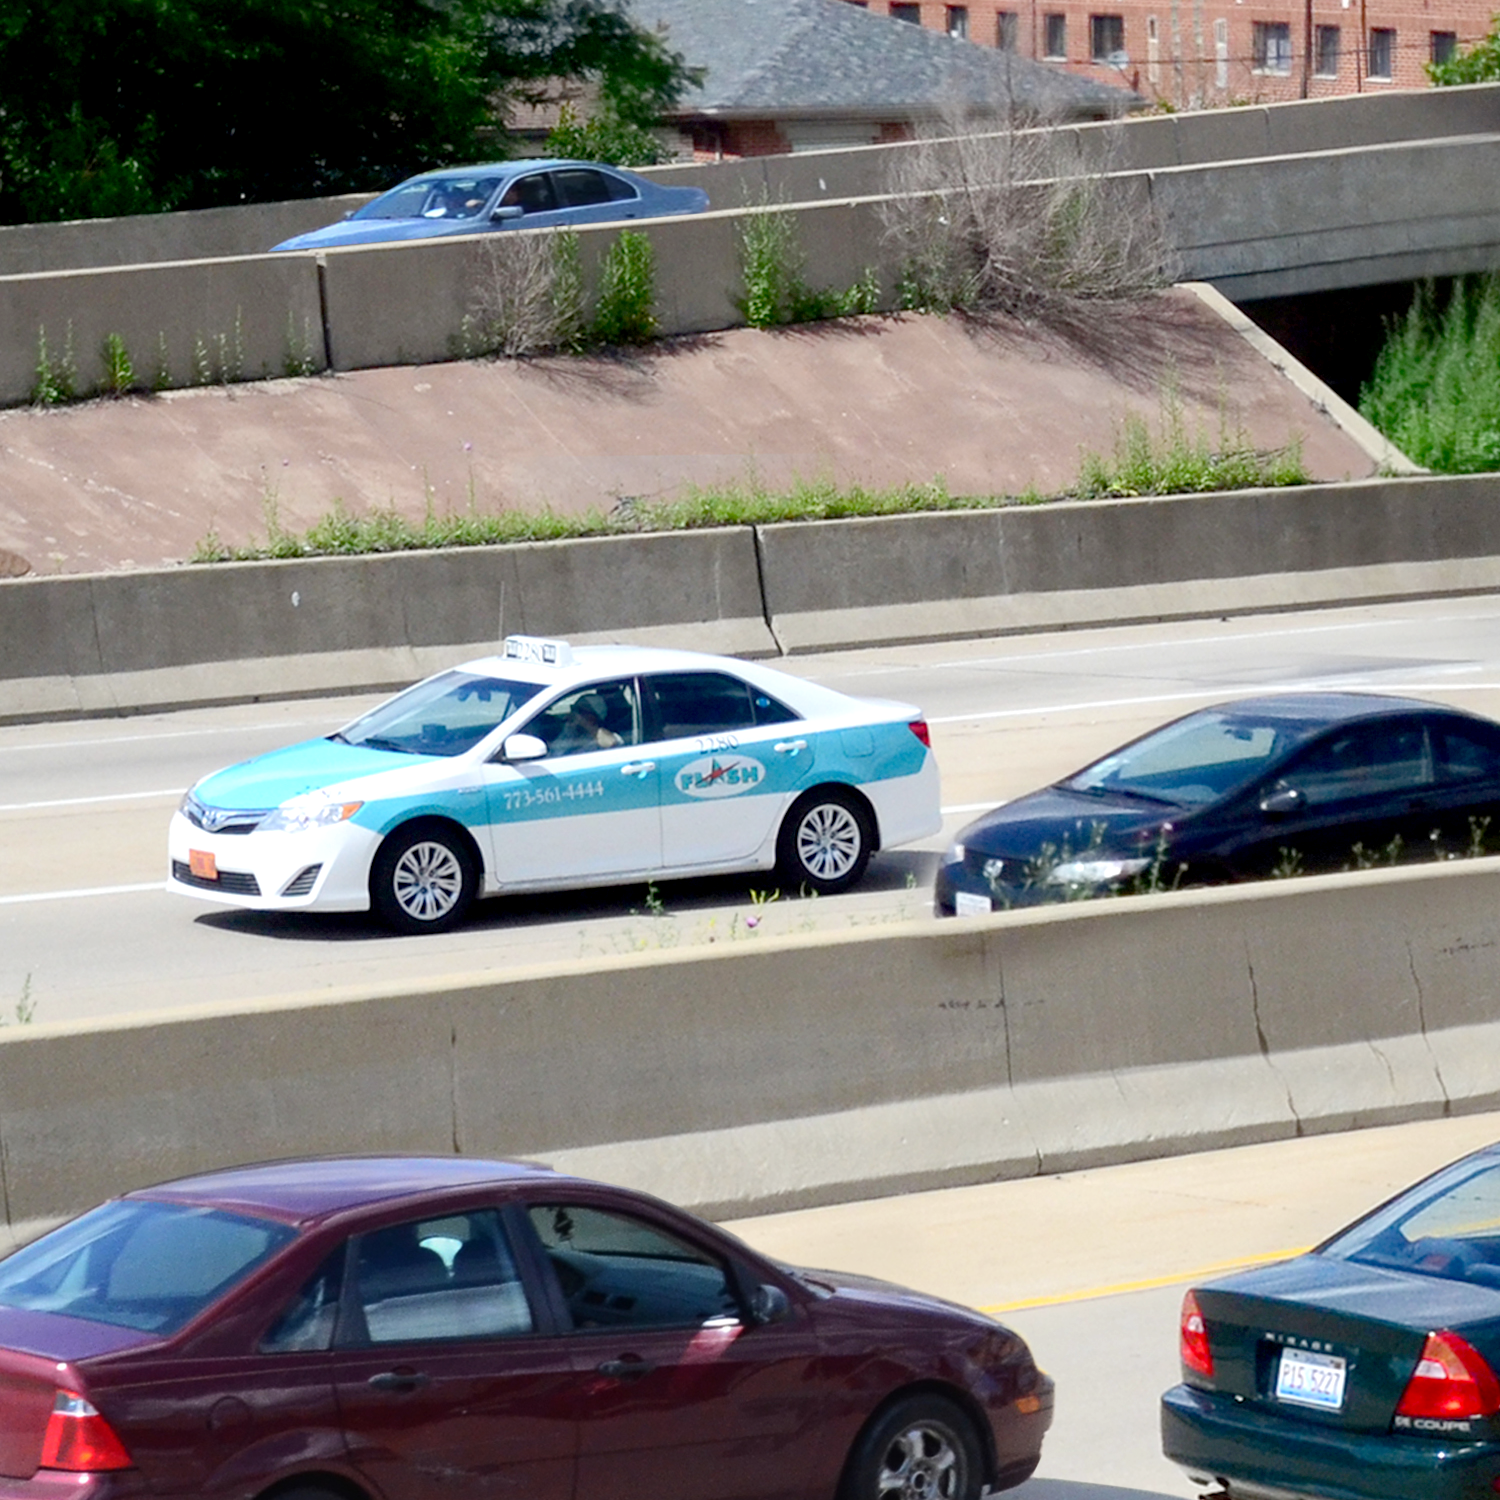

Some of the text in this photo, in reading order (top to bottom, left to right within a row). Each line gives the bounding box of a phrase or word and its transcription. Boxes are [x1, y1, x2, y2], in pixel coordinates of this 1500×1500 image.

[695, 734, 739, 755] 2280
[680, 757, 759, 791] FLASH
[504, 780, 605, 810] 773-561-4444
[1265, 1332, 1334, 1352] MIRAGE
[1413, 1418, 1471, 1432] COUPE
